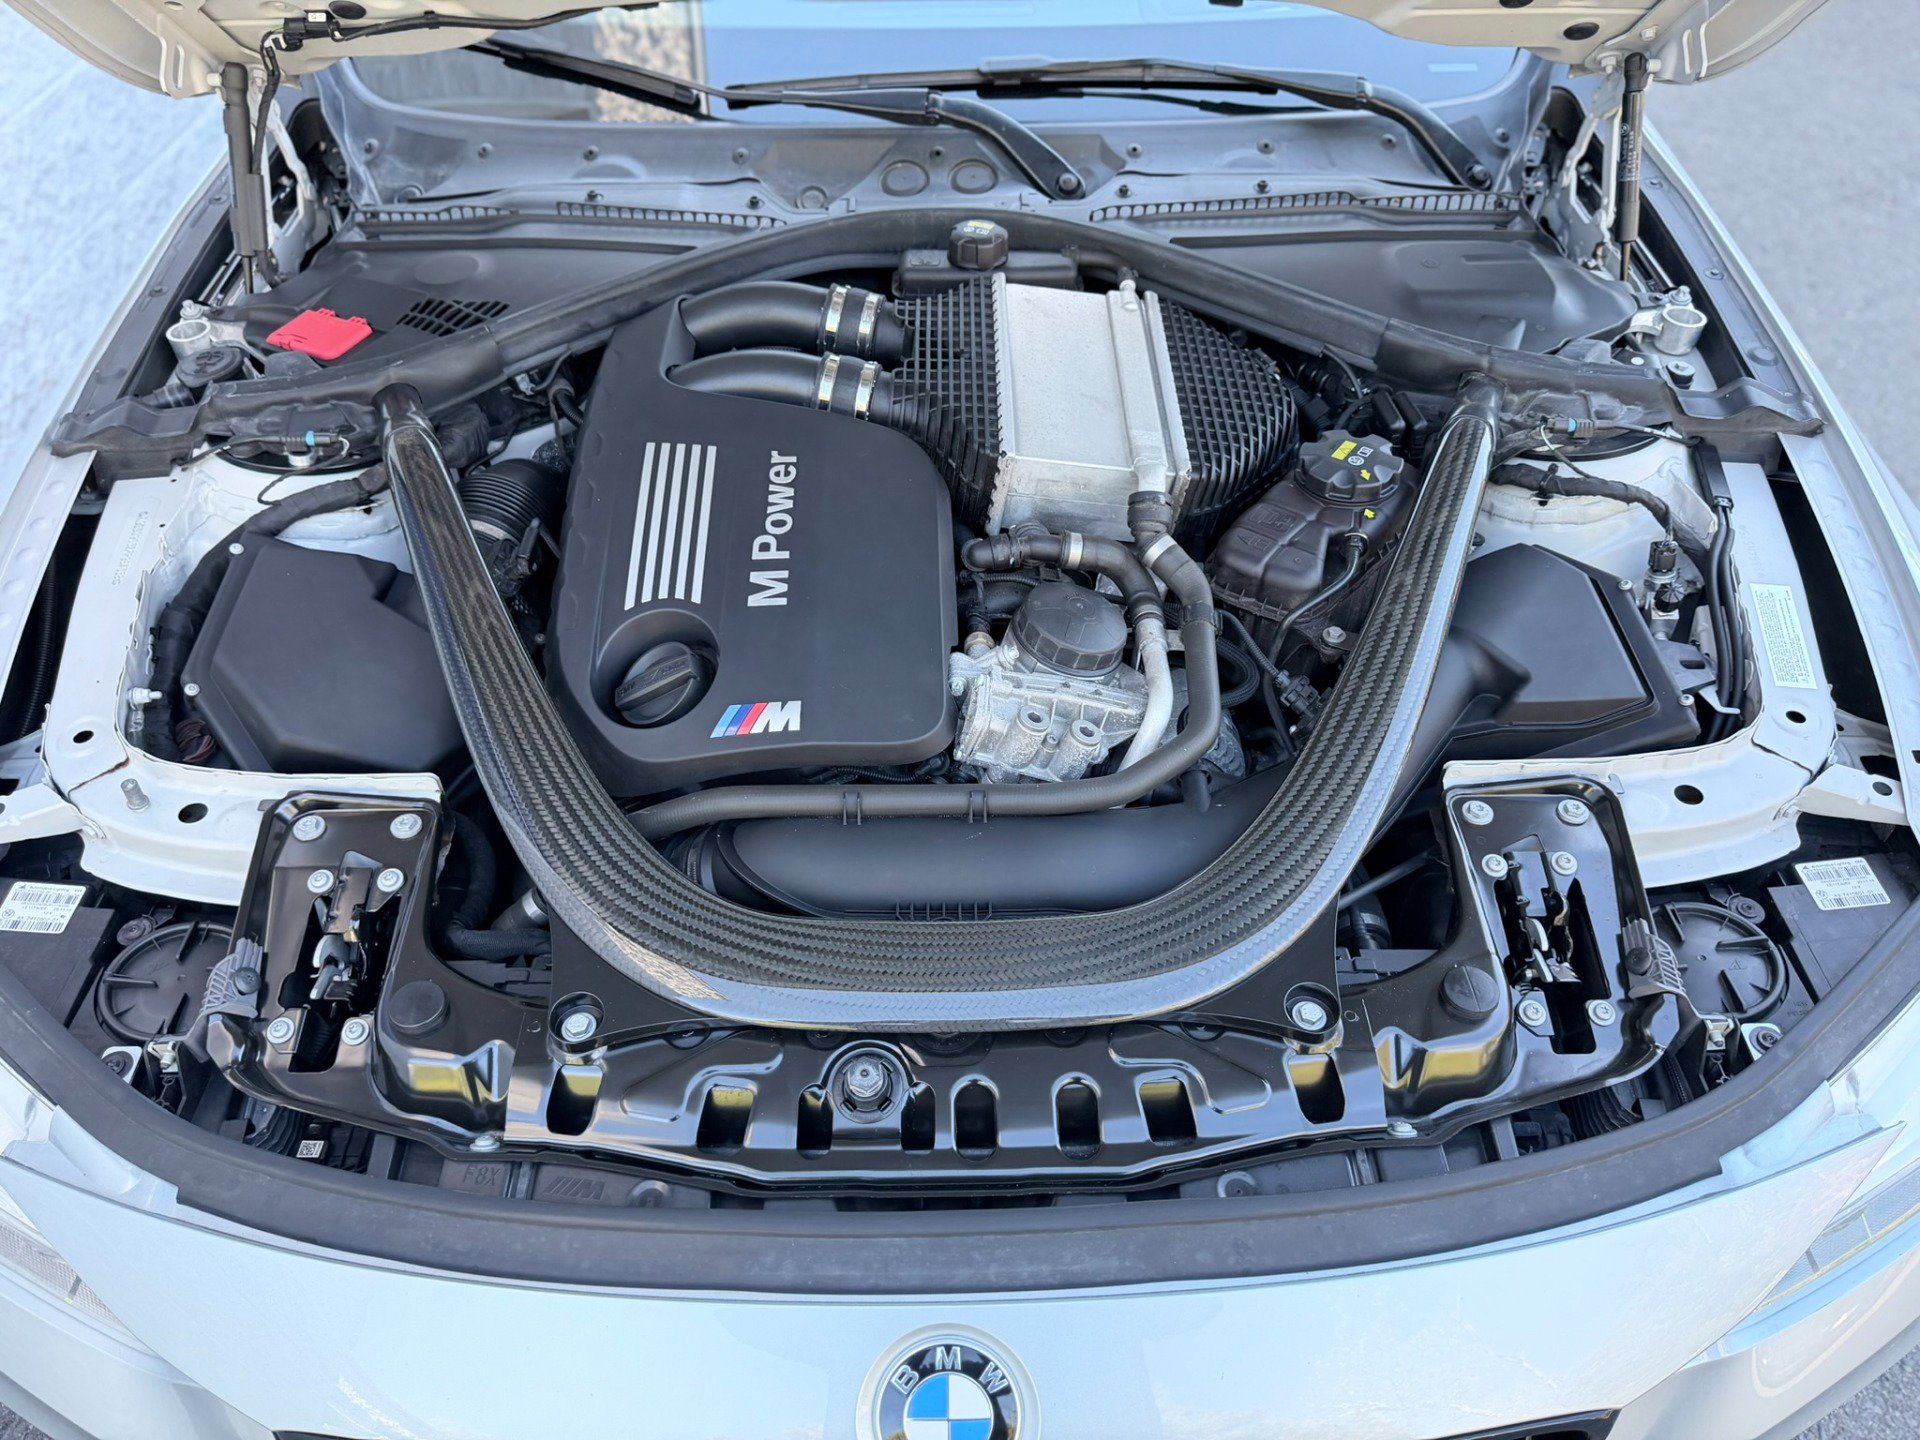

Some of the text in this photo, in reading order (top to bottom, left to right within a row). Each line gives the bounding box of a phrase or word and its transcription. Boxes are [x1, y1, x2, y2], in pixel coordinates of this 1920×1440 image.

[747, 450, 797, 607] M Power
[462, 1163, 502, 1187] F8X
[890, 1345, 1009, 1395] BMW
